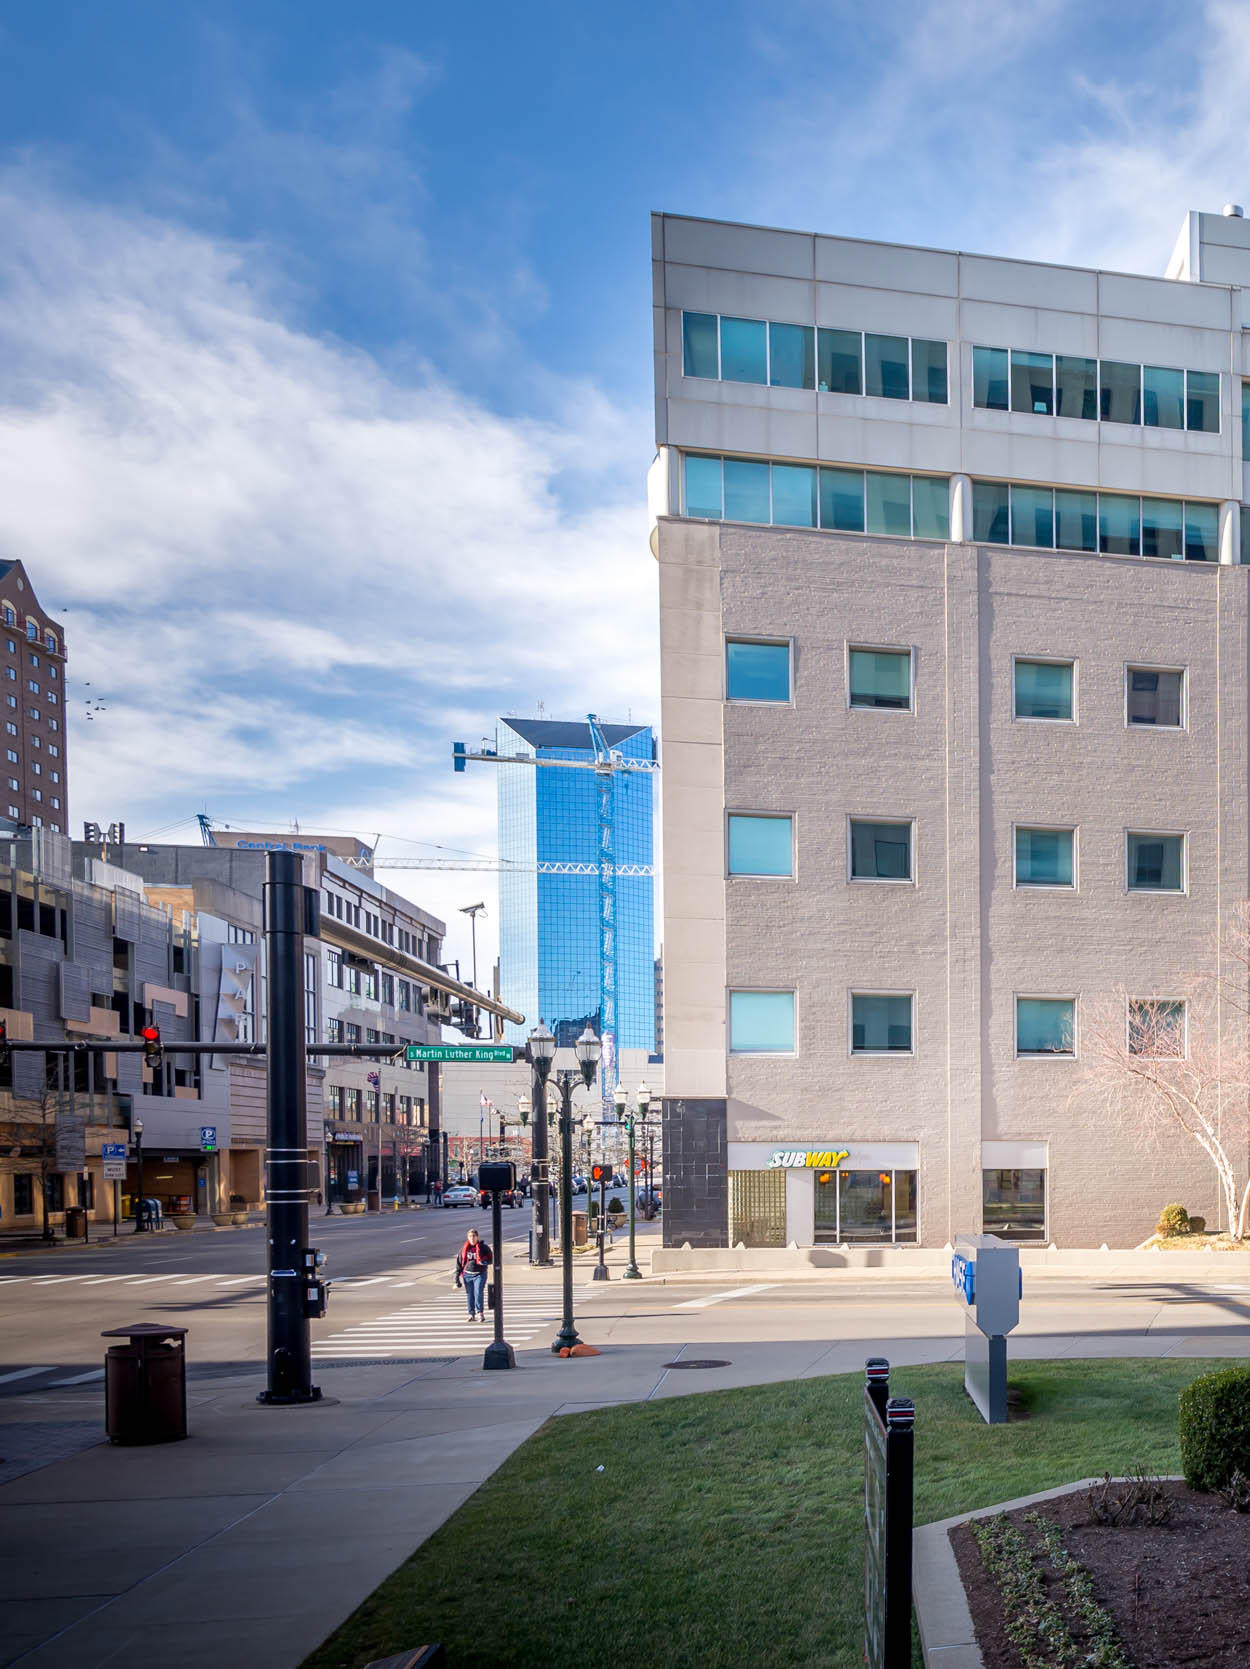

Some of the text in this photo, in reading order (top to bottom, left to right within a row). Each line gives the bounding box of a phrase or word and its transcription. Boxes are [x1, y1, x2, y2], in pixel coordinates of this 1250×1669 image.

[236, 840, 326, 851] Central Bank
[416, 1049, 442, 1059] Martin
[445, 1050, 472, 1059] Luther
[475, 1050, 494, 1061] King
[107, 1146, 115, 1155] P
[769, 1150, 849, 1168] SUBWAY
